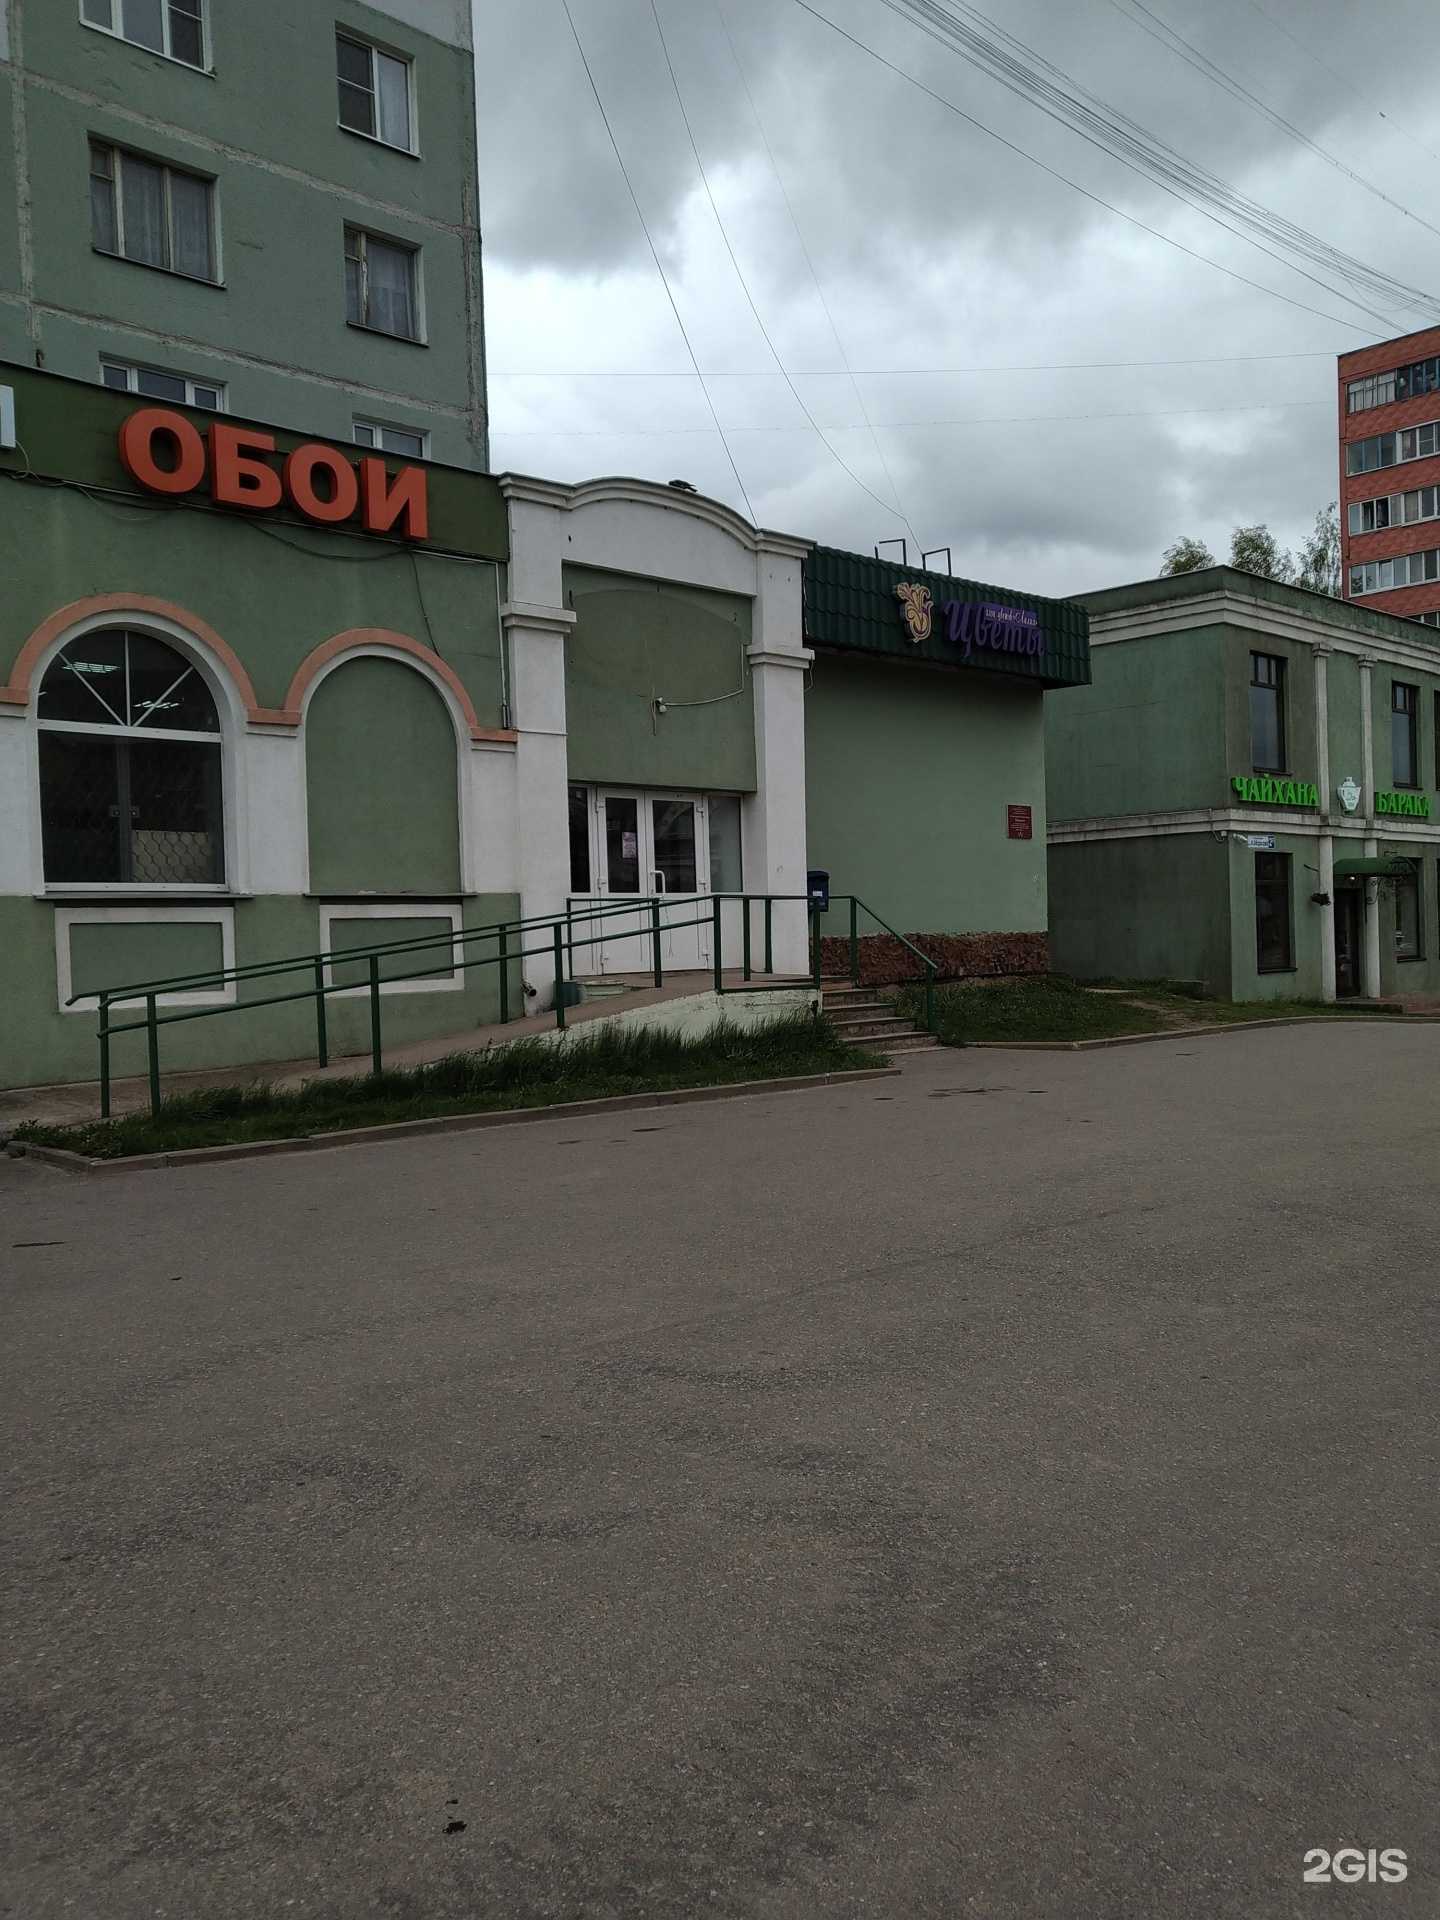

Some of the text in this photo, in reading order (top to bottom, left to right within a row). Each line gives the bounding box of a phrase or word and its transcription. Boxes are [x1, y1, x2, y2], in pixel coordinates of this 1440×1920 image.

[120, 409, 429, 539] ОБОИ
[944, 600, 1046, 658] Цветы
[1231, 774, 1321, 807] ЧАЙХАНА
[1374, 791, 1432, 817] БАРАКА
